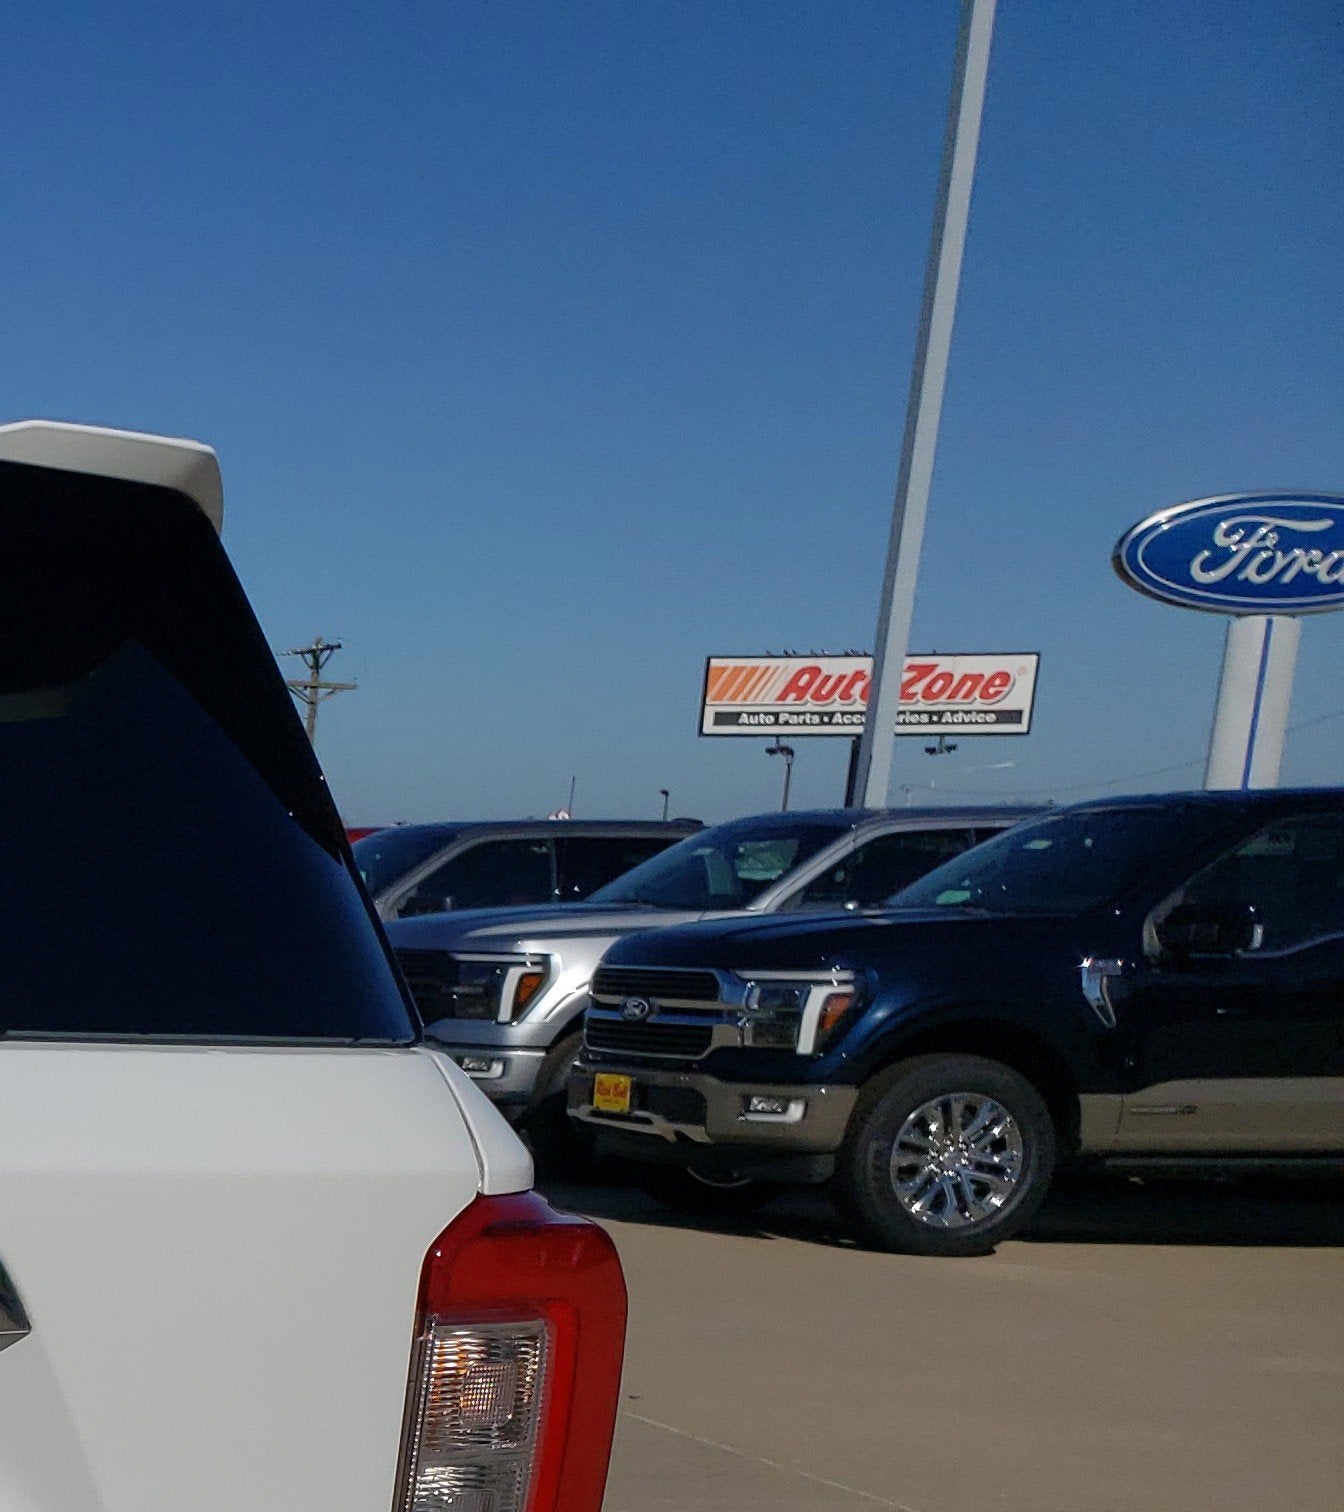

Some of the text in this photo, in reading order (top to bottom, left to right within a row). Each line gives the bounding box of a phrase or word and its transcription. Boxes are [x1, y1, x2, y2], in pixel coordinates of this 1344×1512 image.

[738, 711, 996, 725] Auto Parts Accries Advice
